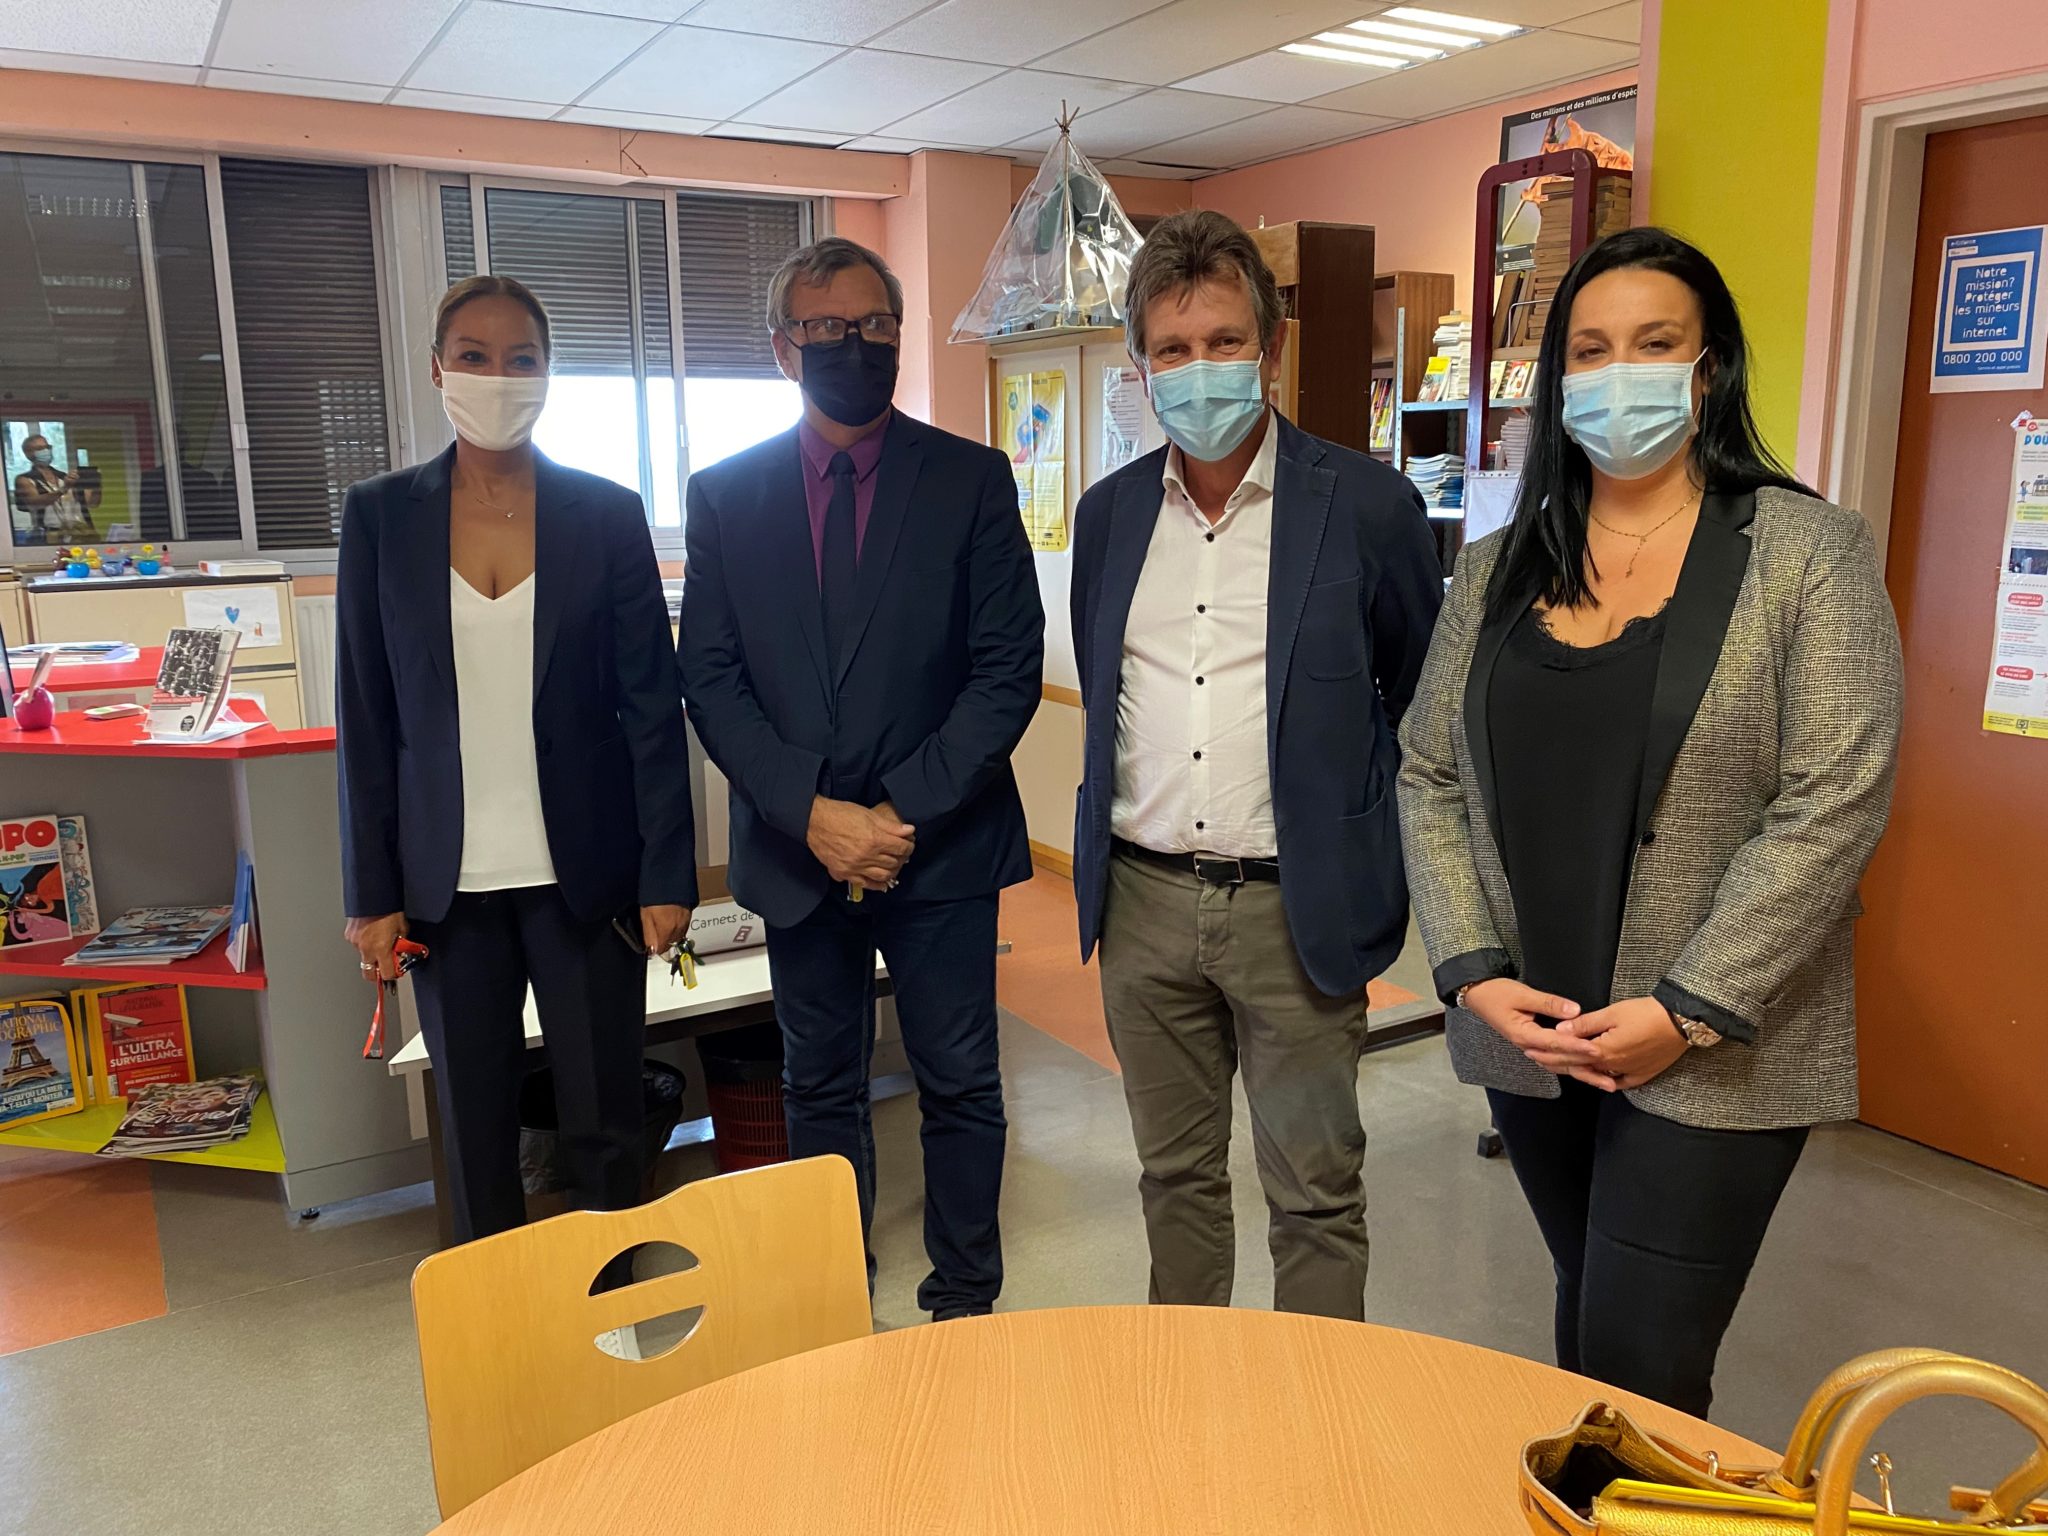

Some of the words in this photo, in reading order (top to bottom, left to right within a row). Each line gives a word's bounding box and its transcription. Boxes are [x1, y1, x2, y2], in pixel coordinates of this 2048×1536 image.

[1531, 112, 1542, 120] Des
[1543, 107, 1565, 117] millions
[1567, 103, 1573, 111] et
[1586, 96, 1610, 106] millions
[1976, 268, 2007, 279] Notre
[1966, 277, 2015, 291] mission?
[1965, 291, 2013, 304] Protéger
[1955, 305, 1971, 316] les
[1975, 303, 2020, 314] mineurs
[1977, 316, 1996, 326] sur
[1963, 326, 2007, 338] internet
[1943, 353, 1971, 365] 0800
[1975, 352, 1996, 363] 200
[2001, 350, 2023, 361] 000
[0, 820, 57, 852] PO
[690, 914, 737, 931] Carnets
[741, 911, 754, 921] de
[0, 1014, 46, 1029] ATIONAL
[0, 1022, 59, 1041] OGRAPHIC
[119, 1038, 176, 1056] L'ULTRA
[110, 1048, 184, 1068] SURVEILLANCE
[0, 1100, 32, 1112] A-T-ELLE
